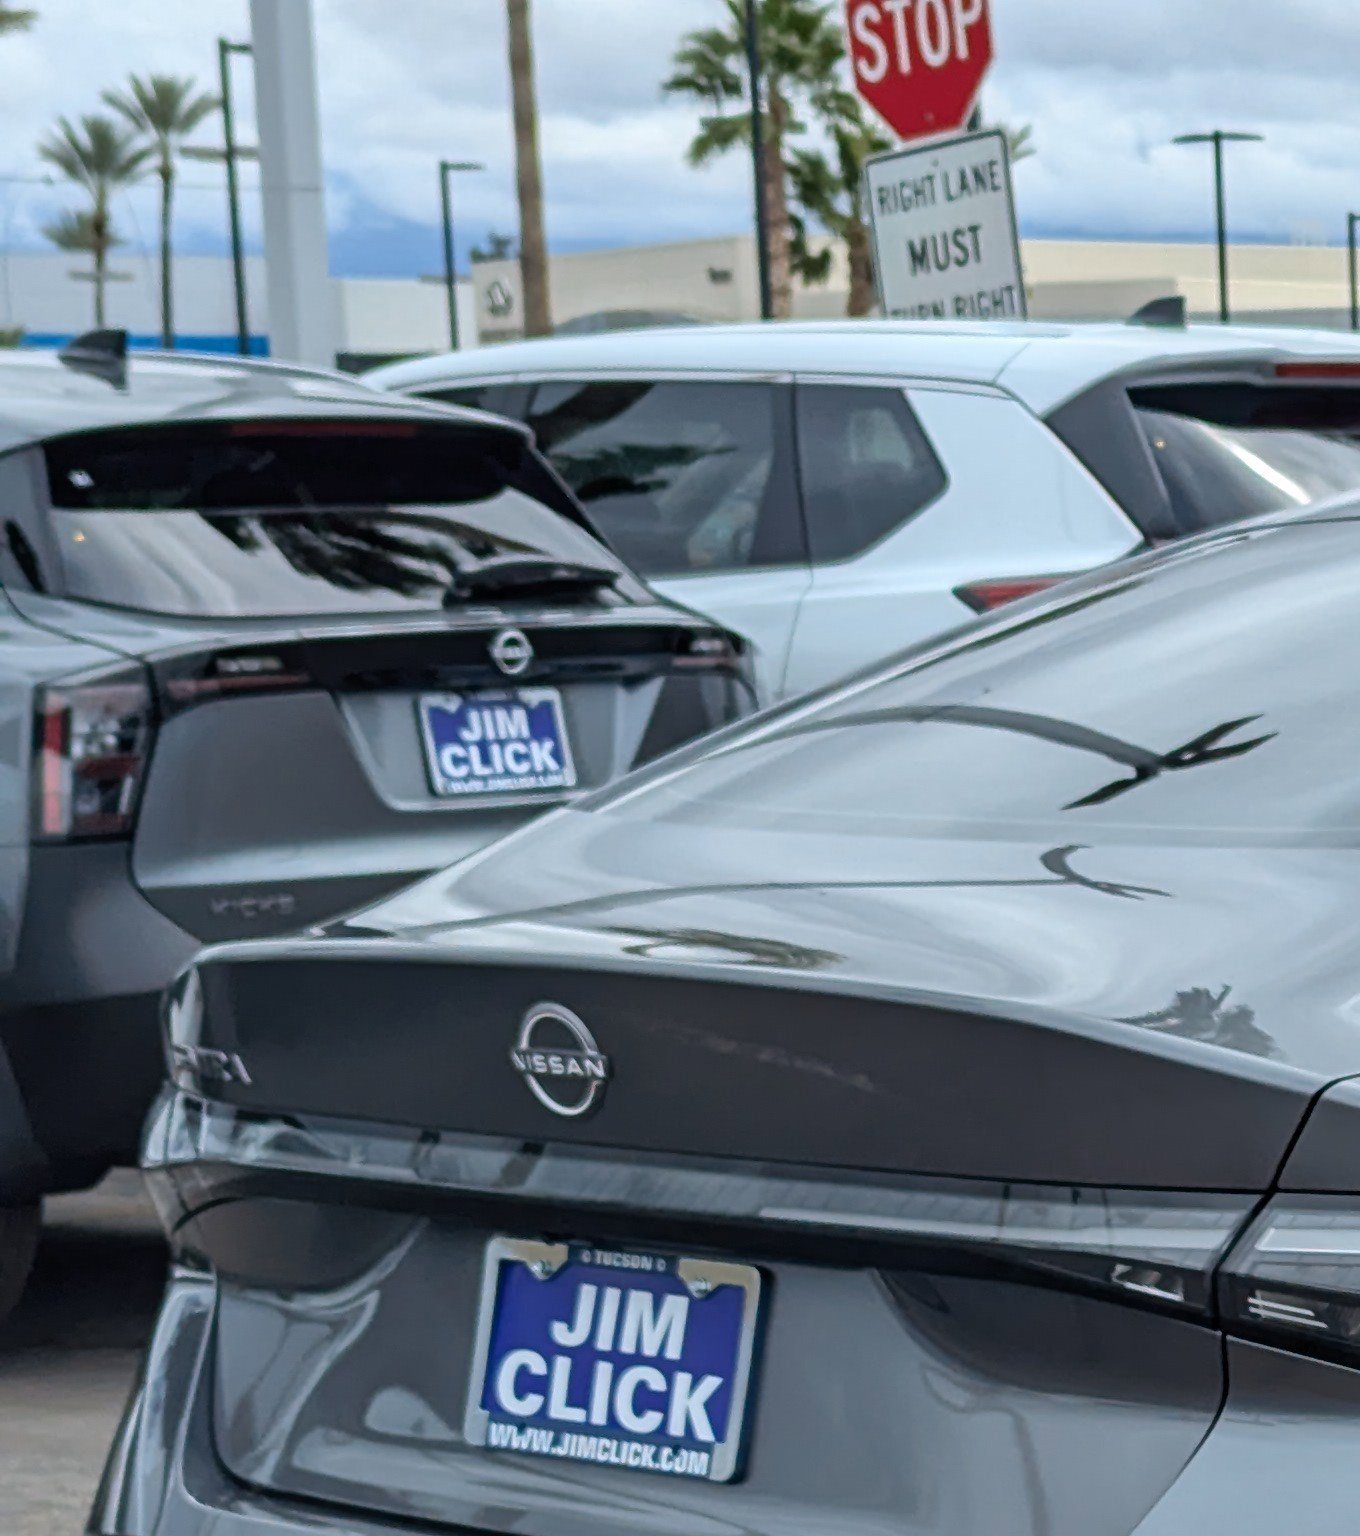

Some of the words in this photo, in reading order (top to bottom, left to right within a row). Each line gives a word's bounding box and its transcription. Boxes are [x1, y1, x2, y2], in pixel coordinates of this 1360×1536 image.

[853, 0, 982, 84] STOP
[876, 174, 937, 216] RIGHT
[942, 158, 1001, 203] LANE
[906, 223, 983, 278] MUST
[458, 704, 531, 743] JIM
[440, 737, 560, 779] CLICK
[511, 1049, 606, 1079] NISSAN
[550, 1282, 690, 1361] JIM
[494, 1348, 725, 1443] CLICK
[488, 1421, 711, 1478] WWW.JIMCLICK.COM
